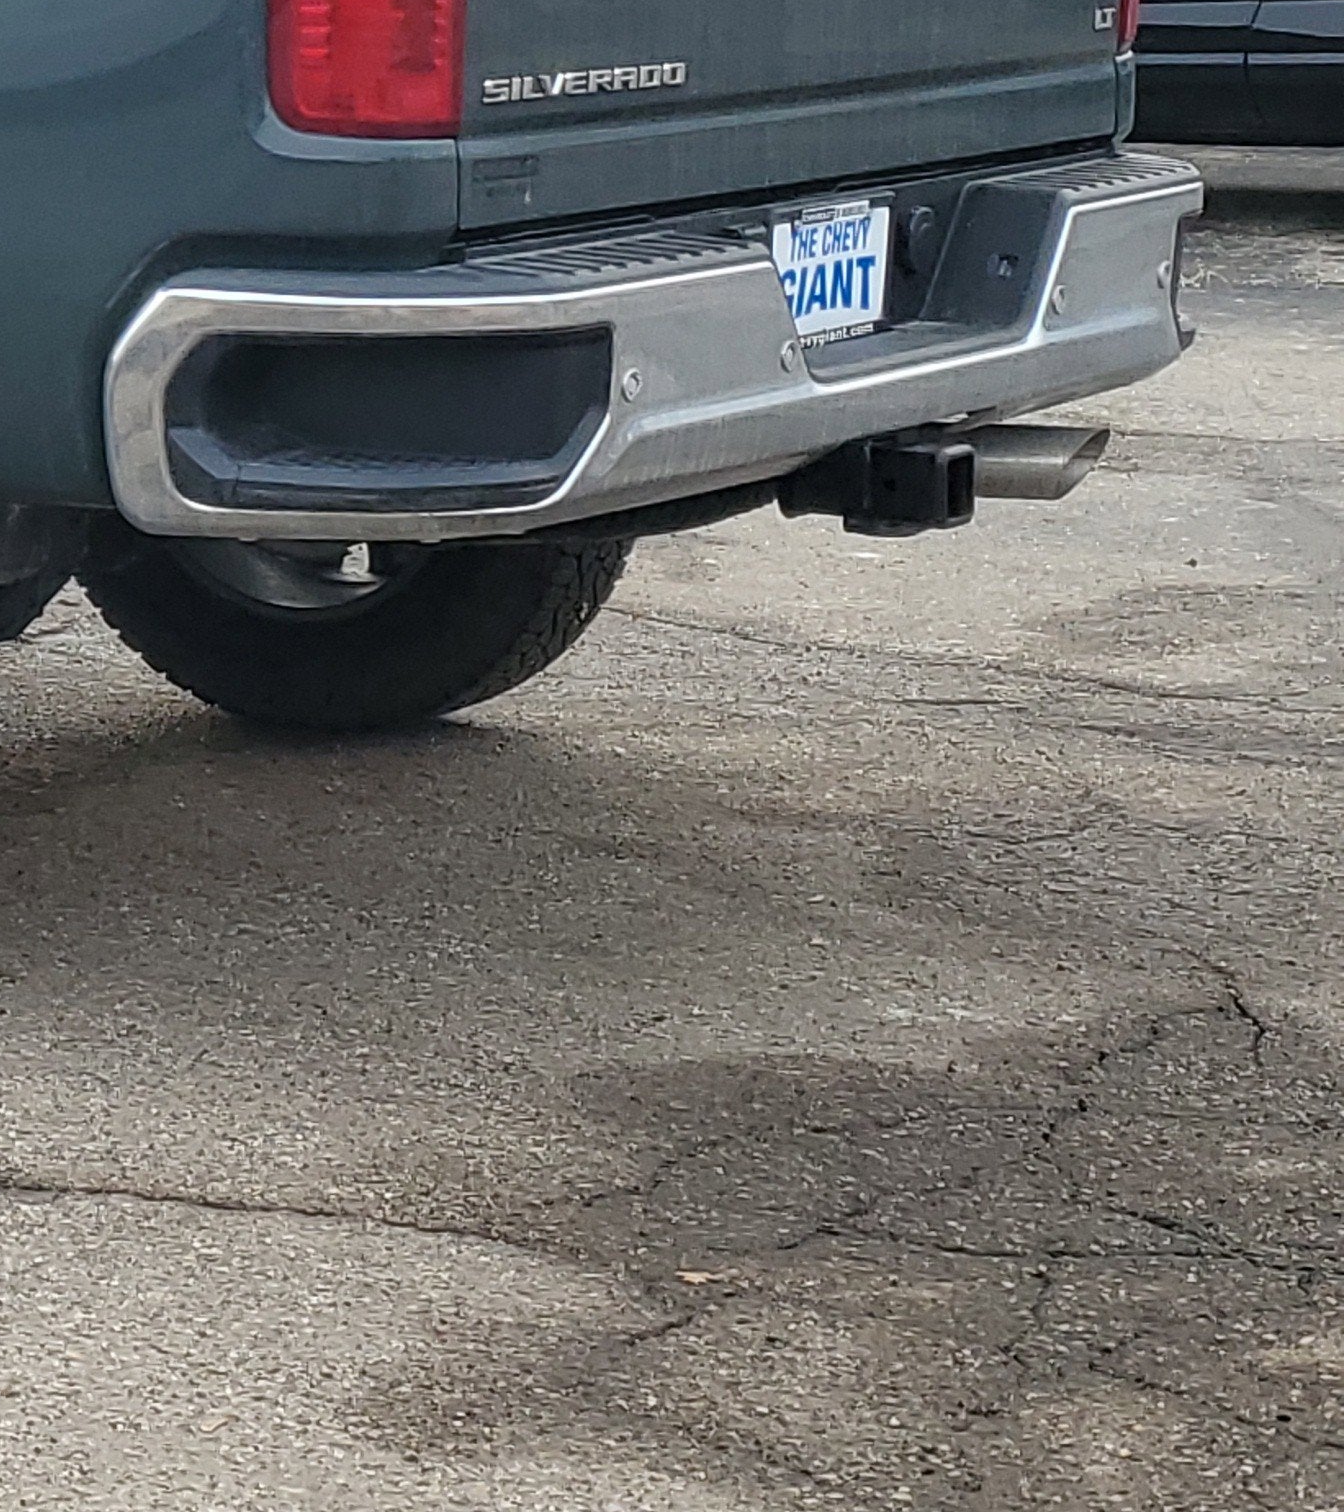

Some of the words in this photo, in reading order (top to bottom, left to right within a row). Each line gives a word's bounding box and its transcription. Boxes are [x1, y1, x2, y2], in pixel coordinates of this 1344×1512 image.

[482, 62, 687, 105] SILVERADO
[791, 225, 818, 263] THE
[822, 216, 871, 256] CHEVY
[780, 255, 876, 319] GIANT
